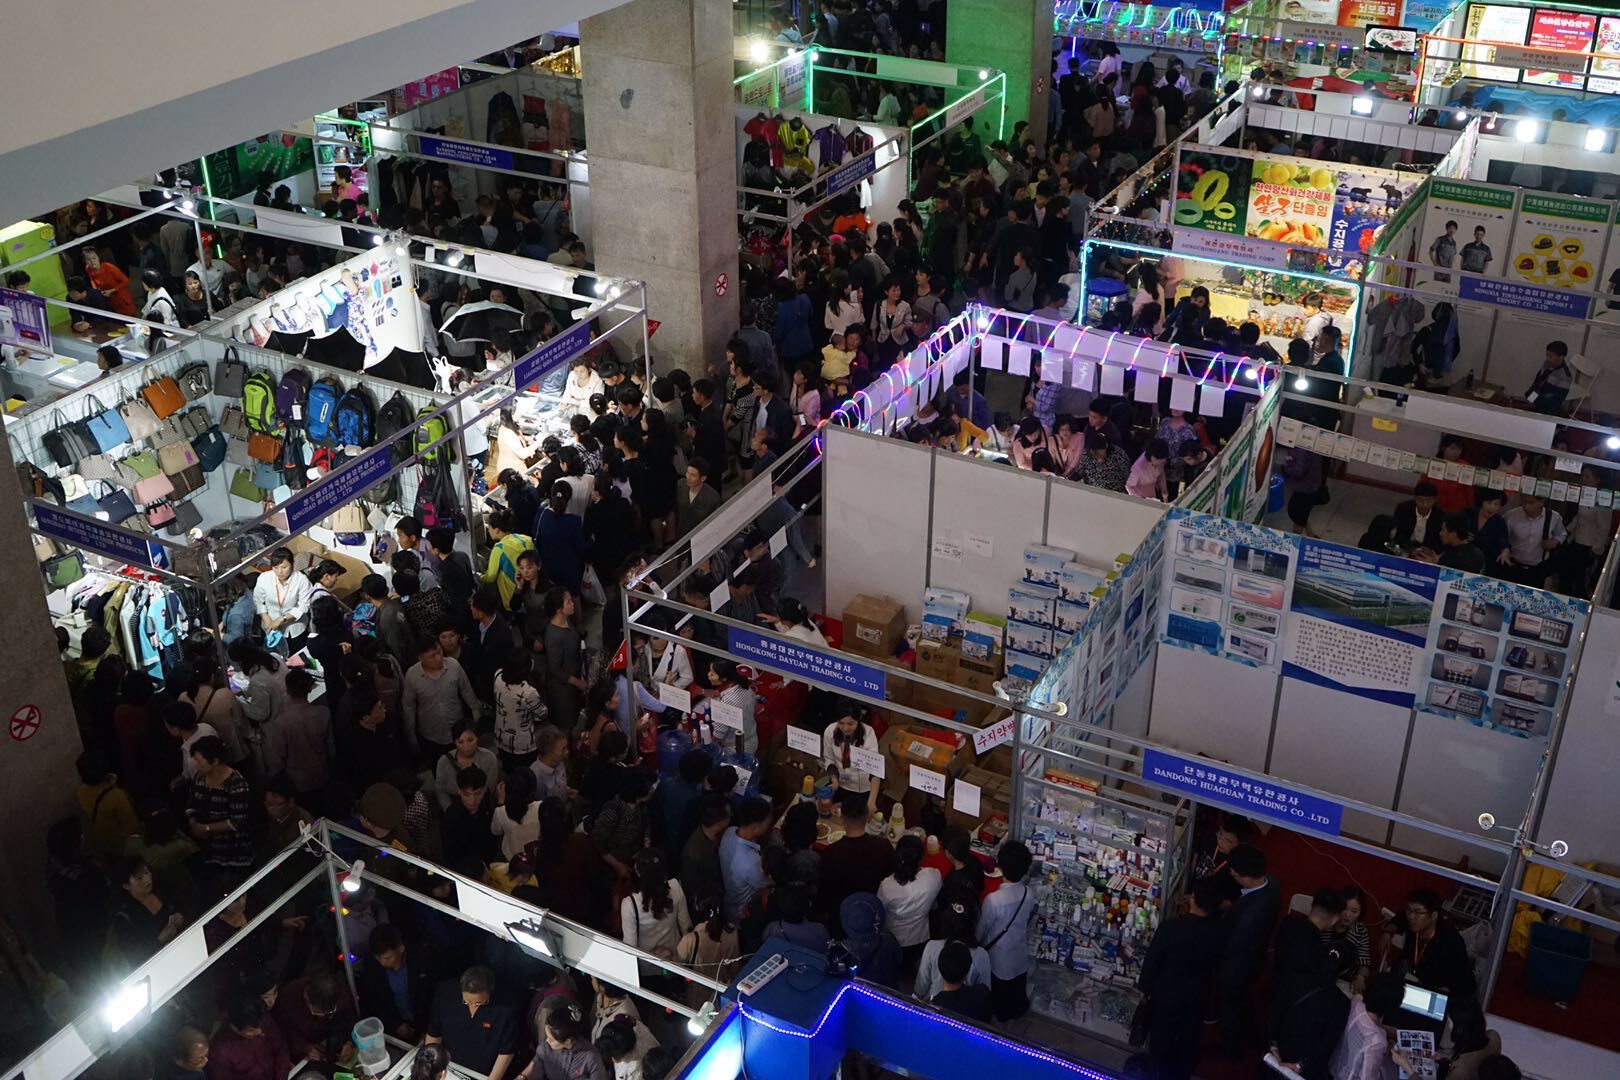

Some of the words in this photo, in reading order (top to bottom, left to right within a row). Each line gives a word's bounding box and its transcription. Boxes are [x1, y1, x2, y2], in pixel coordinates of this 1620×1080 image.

[291, 502, 317, 521] QINGDAO
[336, 476, 360, 494] LEATHER
[735, 641, 777, 660] HONGKONG
[778, 655, 809, 671] DAYUAN
[811, 664, 843, 680] TRADING
[1154, 767, 1198, 786] DANDONG
[1200, 781, 1244, 799] HUAGUAN
[1247, 794, 1287, 812] TRADING
